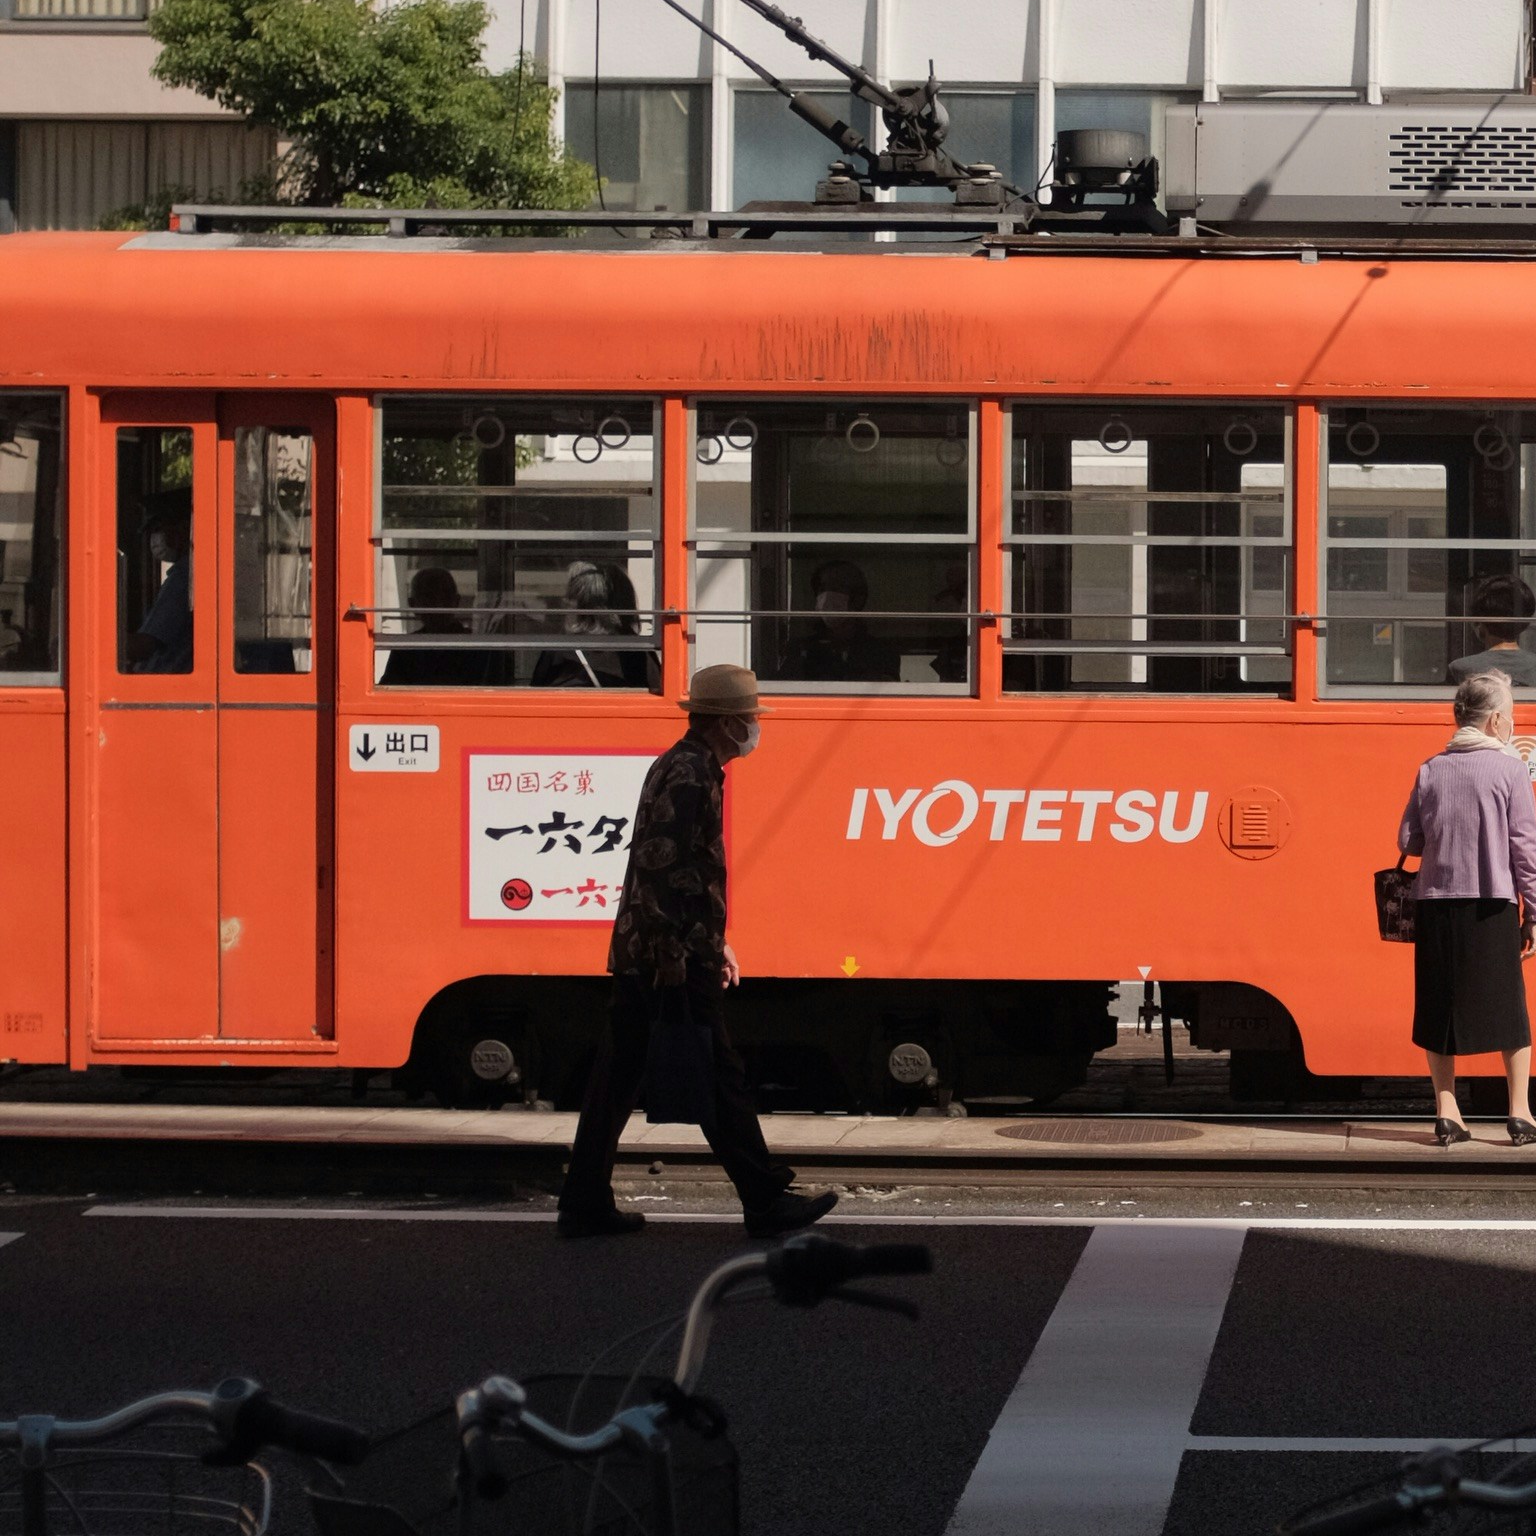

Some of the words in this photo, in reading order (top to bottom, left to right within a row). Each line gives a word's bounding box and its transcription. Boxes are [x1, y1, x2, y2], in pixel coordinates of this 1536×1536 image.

[385, 732, 429, 753] 出口
[398, 757, 417, 766] Exit
[486, 769, 596, 796] 四国名菓
[845, 779, 1209, 847] IYOTETSU
[484, 810, 633, 855] 一六タ
[540, 878, 624, 908] 一六
